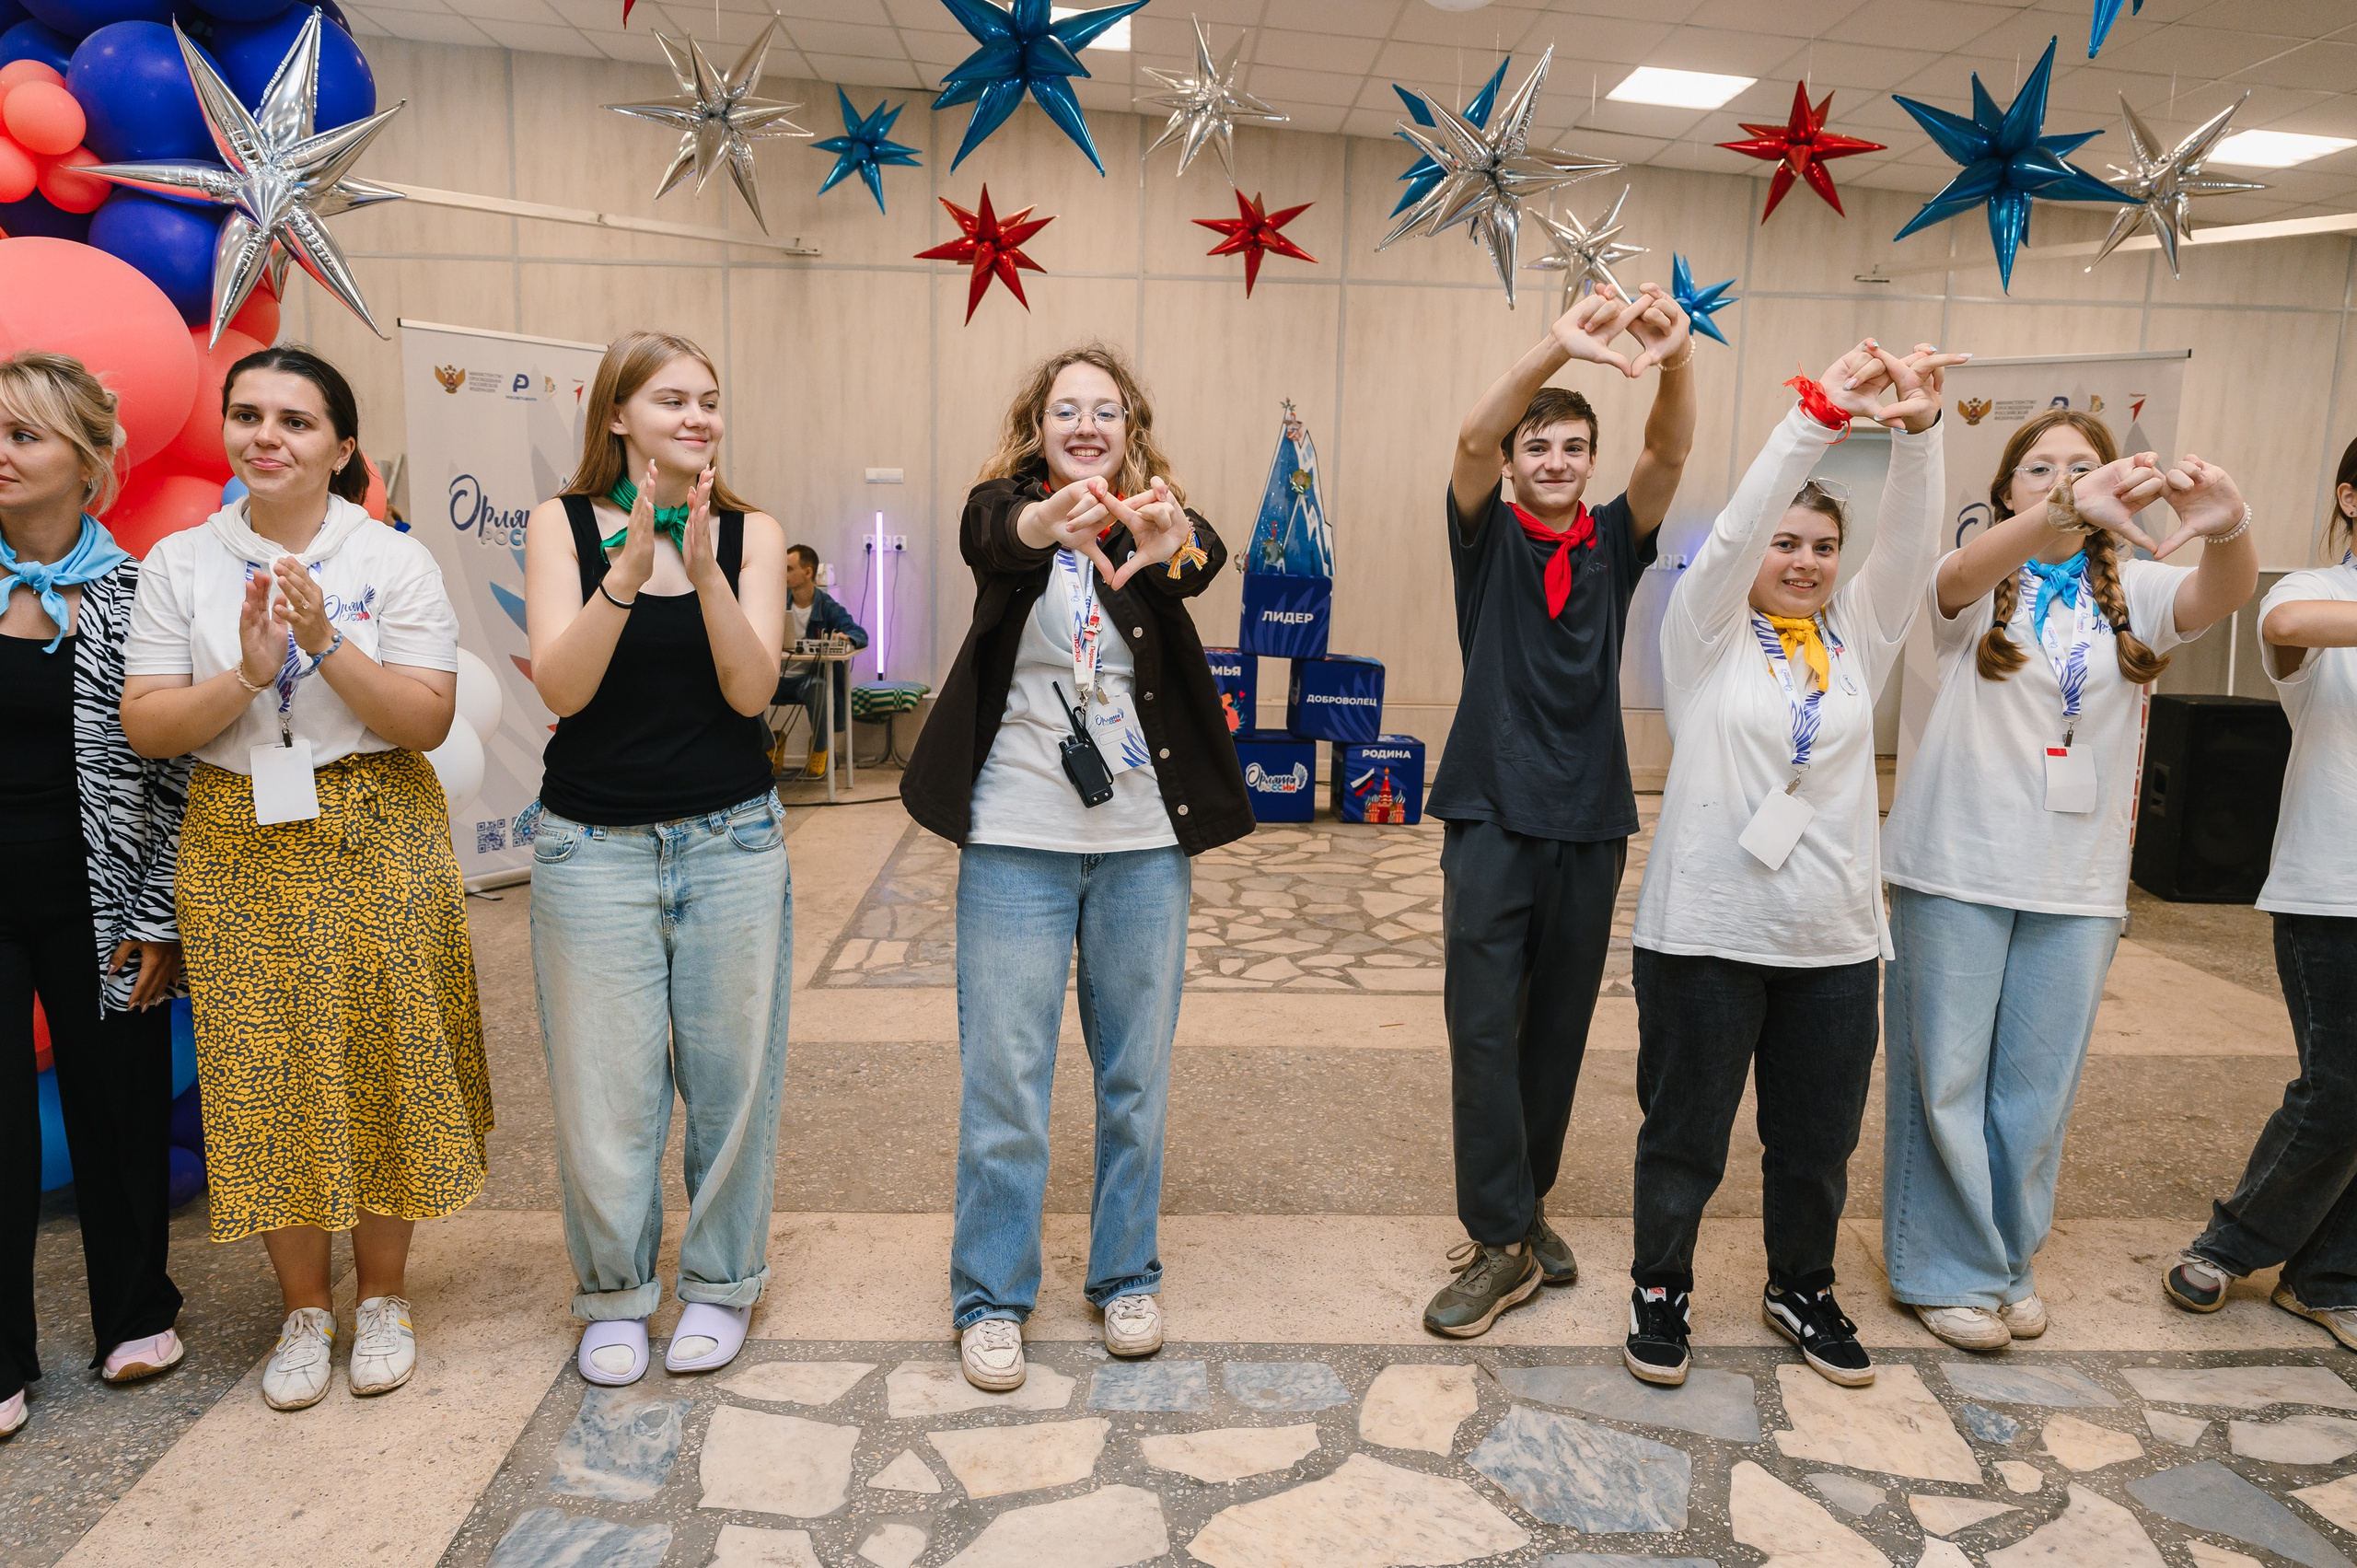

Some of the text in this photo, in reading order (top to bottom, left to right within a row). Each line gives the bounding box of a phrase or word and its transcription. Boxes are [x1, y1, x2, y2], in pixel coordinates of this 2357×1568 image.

[1261, 610, 1314, 624] ЛИДЕР
[1209, 665, 1242, 677] МЬЯ
[1306, 694, 1377, 707] ДОБРОВОЛЕЦ
[1362, 749, 1411, 760] РОДИНА
